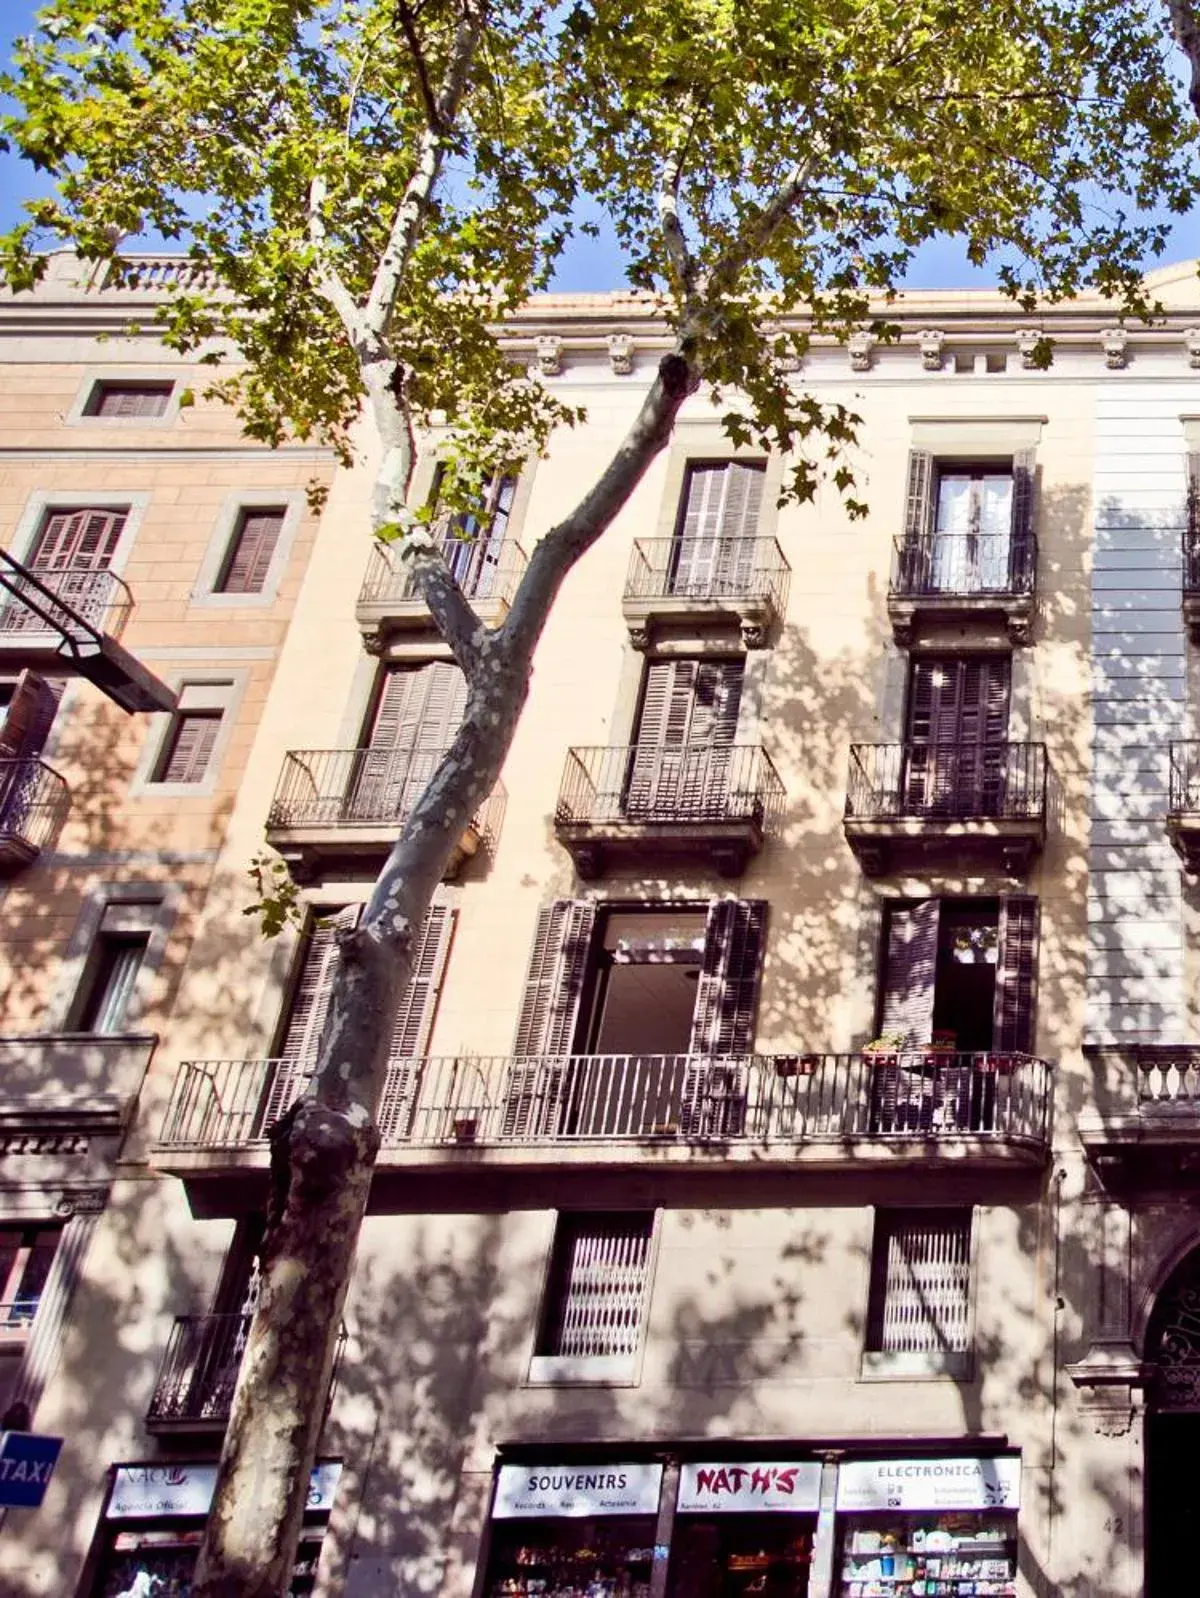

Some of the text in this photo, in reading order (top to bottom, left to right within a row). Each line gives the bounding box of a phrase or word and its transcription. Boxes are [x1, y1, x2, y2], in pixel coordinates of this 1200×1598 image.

[1, 1458, 53, 1483] TAXI
[528, 1474, 627, 1492] SOUVENIRS
[696, 1467, 800, 1495] NATH'S
